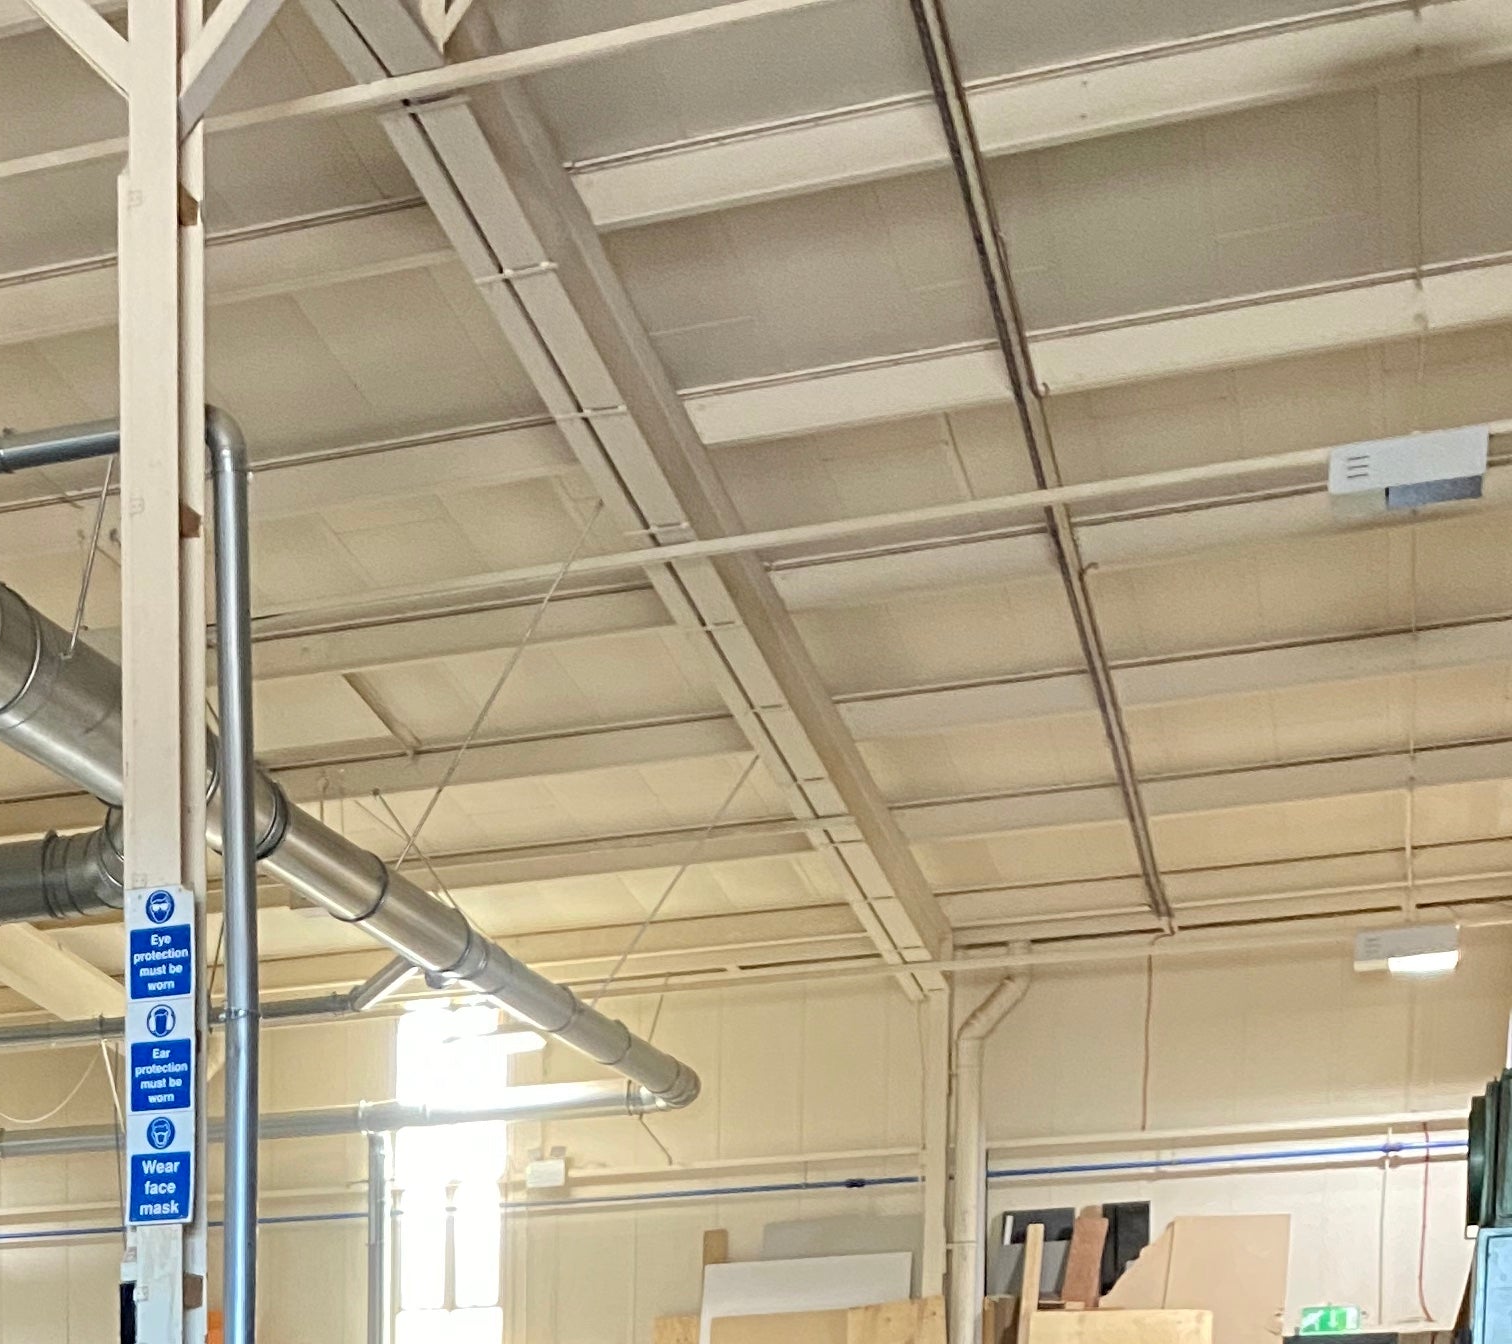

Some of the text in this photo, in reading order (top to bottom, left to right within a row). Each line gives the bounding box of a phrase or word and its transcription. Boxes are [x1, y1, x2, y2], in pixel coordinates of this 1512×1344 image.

[150, 933, 172, 947] Eye
[133, 947, 189, 965] protection
[139, 962, 183, 977] must be
[147, 980, 175, 991] worn
[152, 1048, 171, 1059] Ear
[134, 1062, 188, 1078] protection
[140, 1076, 183, 1090] must be
[147, 1093, 175, 1104] worn
[141, 1159, 180, 1175] Wear
[144, 1180, 176, 1195] face
[139, 1199, 179, 1216] mask
